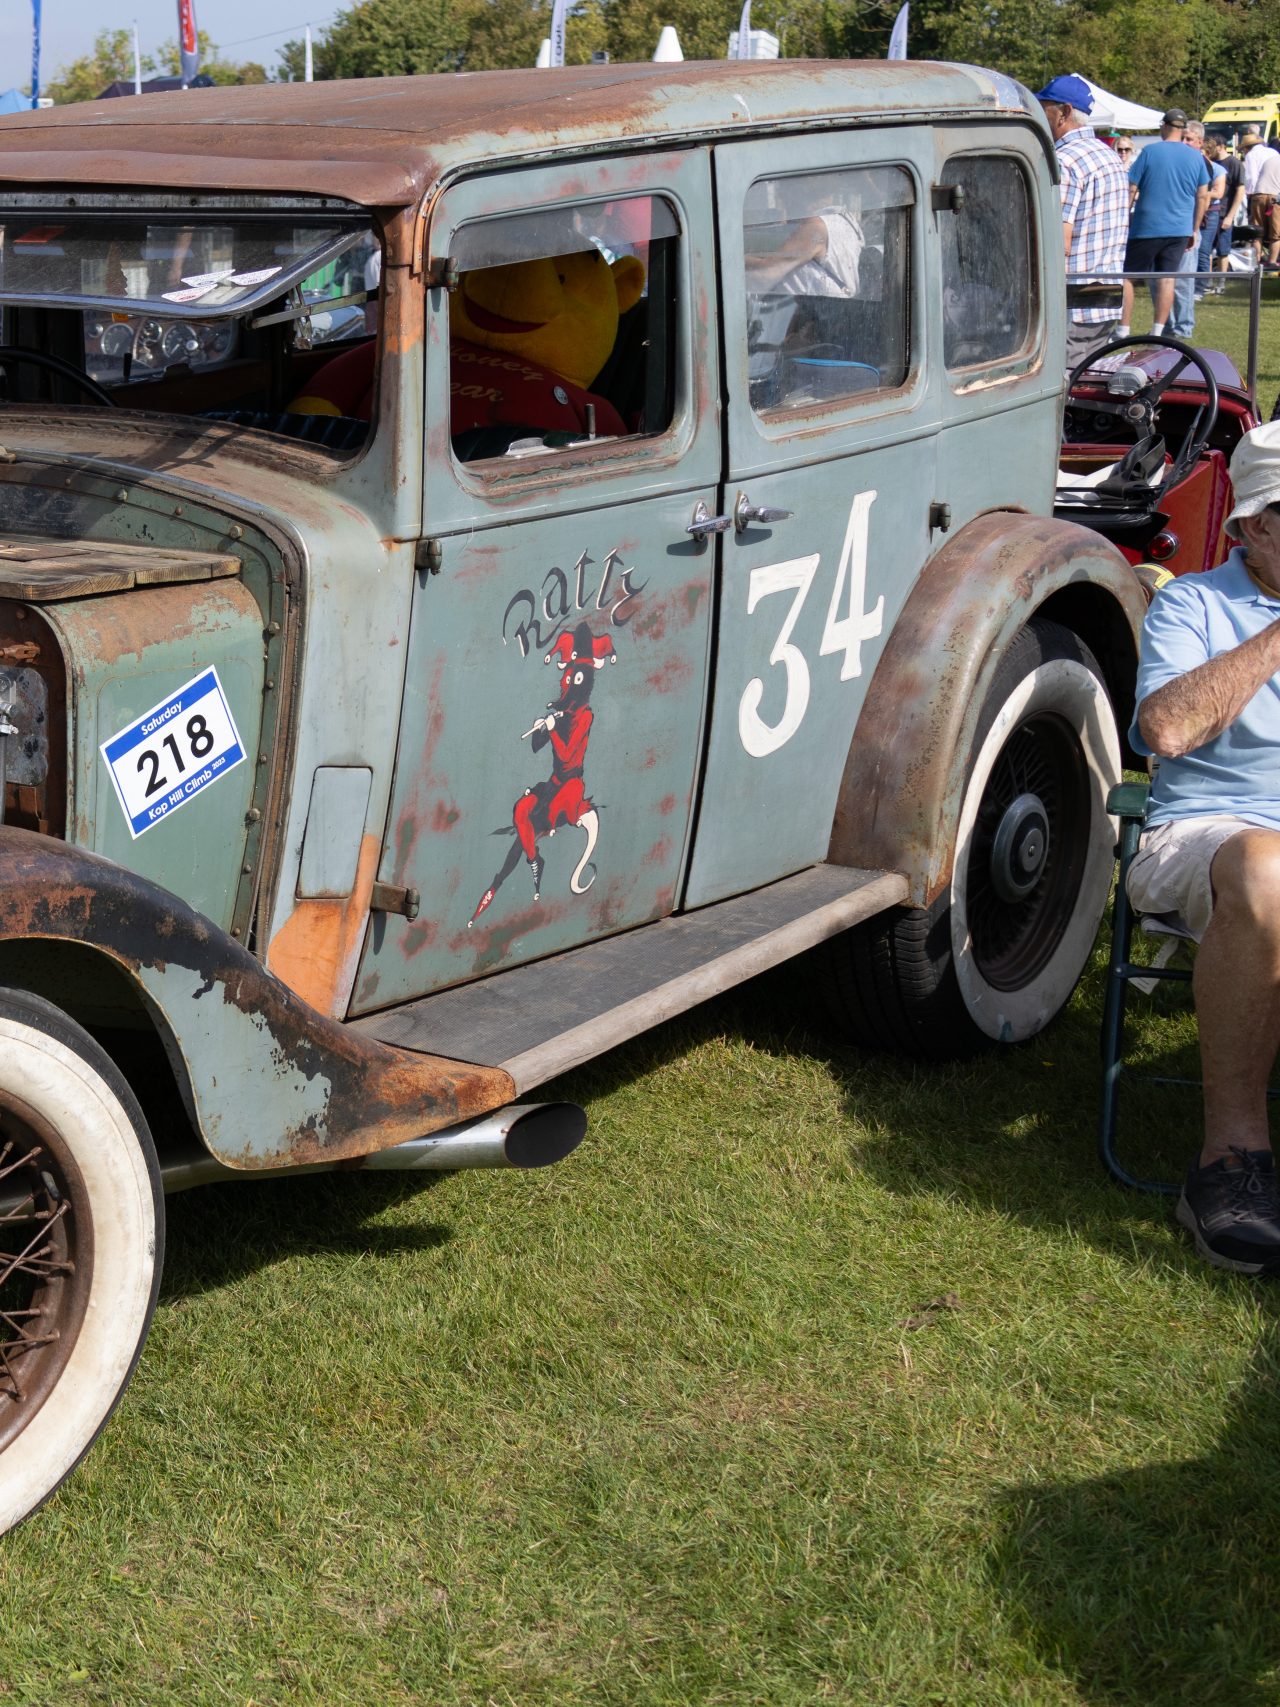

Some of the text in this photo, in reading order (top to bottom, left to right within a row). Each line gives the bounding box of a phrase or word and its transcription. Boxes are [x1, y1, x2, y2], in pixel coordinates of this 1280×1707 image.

[503, 548, 650, 658] Ratty
[738, 489, 884, 758] 34
[136, 714, 215, 798] 218
[141, 701, 183, 736] Saturday
[148, 757, 226, 820] Kop Hill Climb 2023
